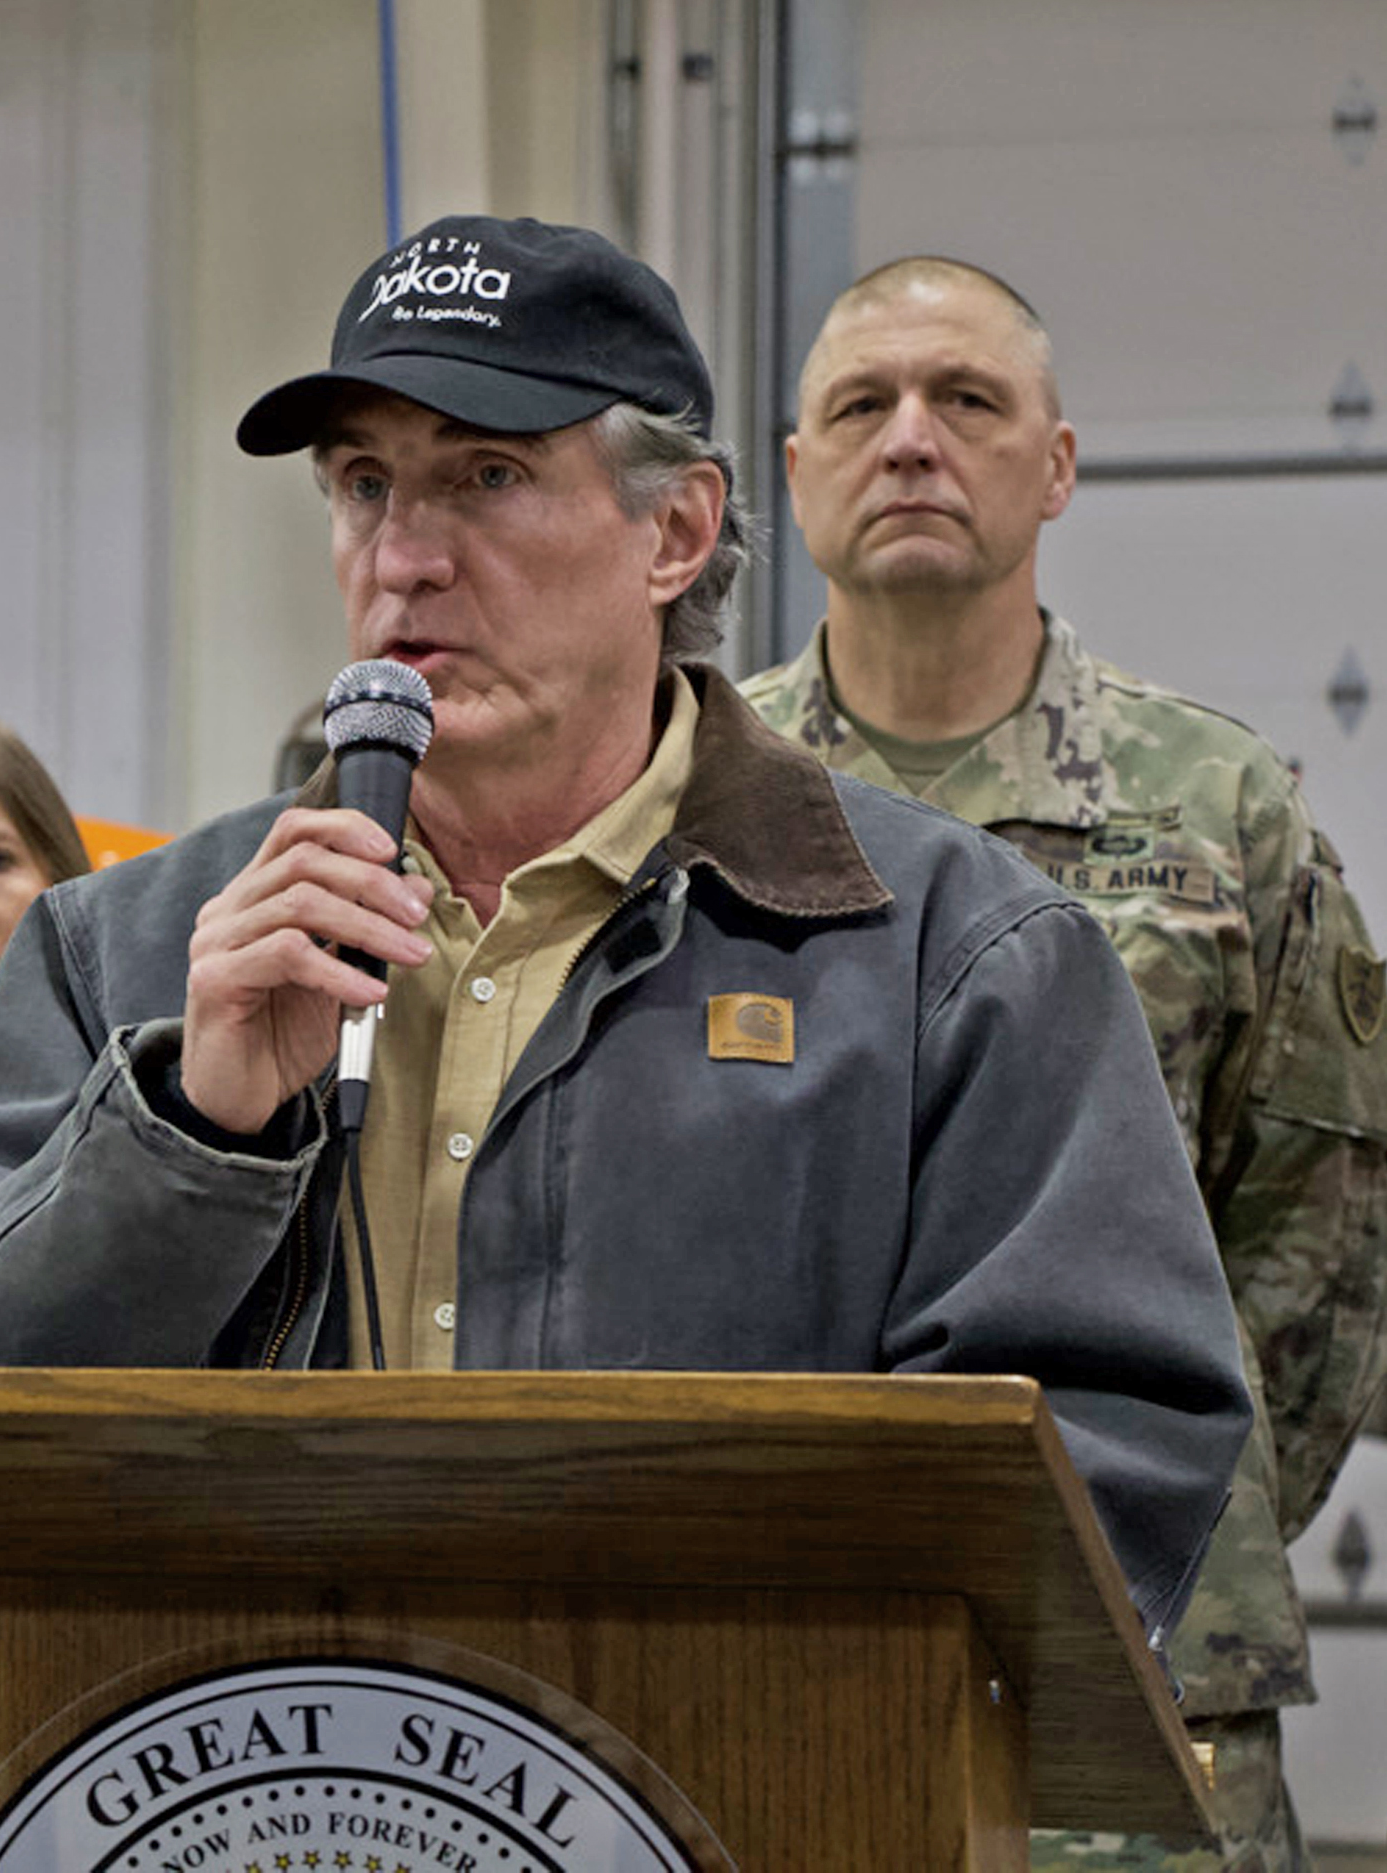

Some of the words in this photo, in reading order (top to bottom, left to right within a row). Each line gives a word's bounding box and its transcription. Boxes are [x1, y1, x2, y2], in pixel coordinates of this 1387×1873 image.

[389, 238, 481, 268] NORTH
[392, 305, 414, 321] Be
[1108, 865, 1187, 891] ARMY
[86, 1704, 333, 1827] GREAT
[394, 1713, 578, 1849] SEAL
[247, 1813, 311, 1844] AND
[328, 1812, 478, 1873] FOREVER
